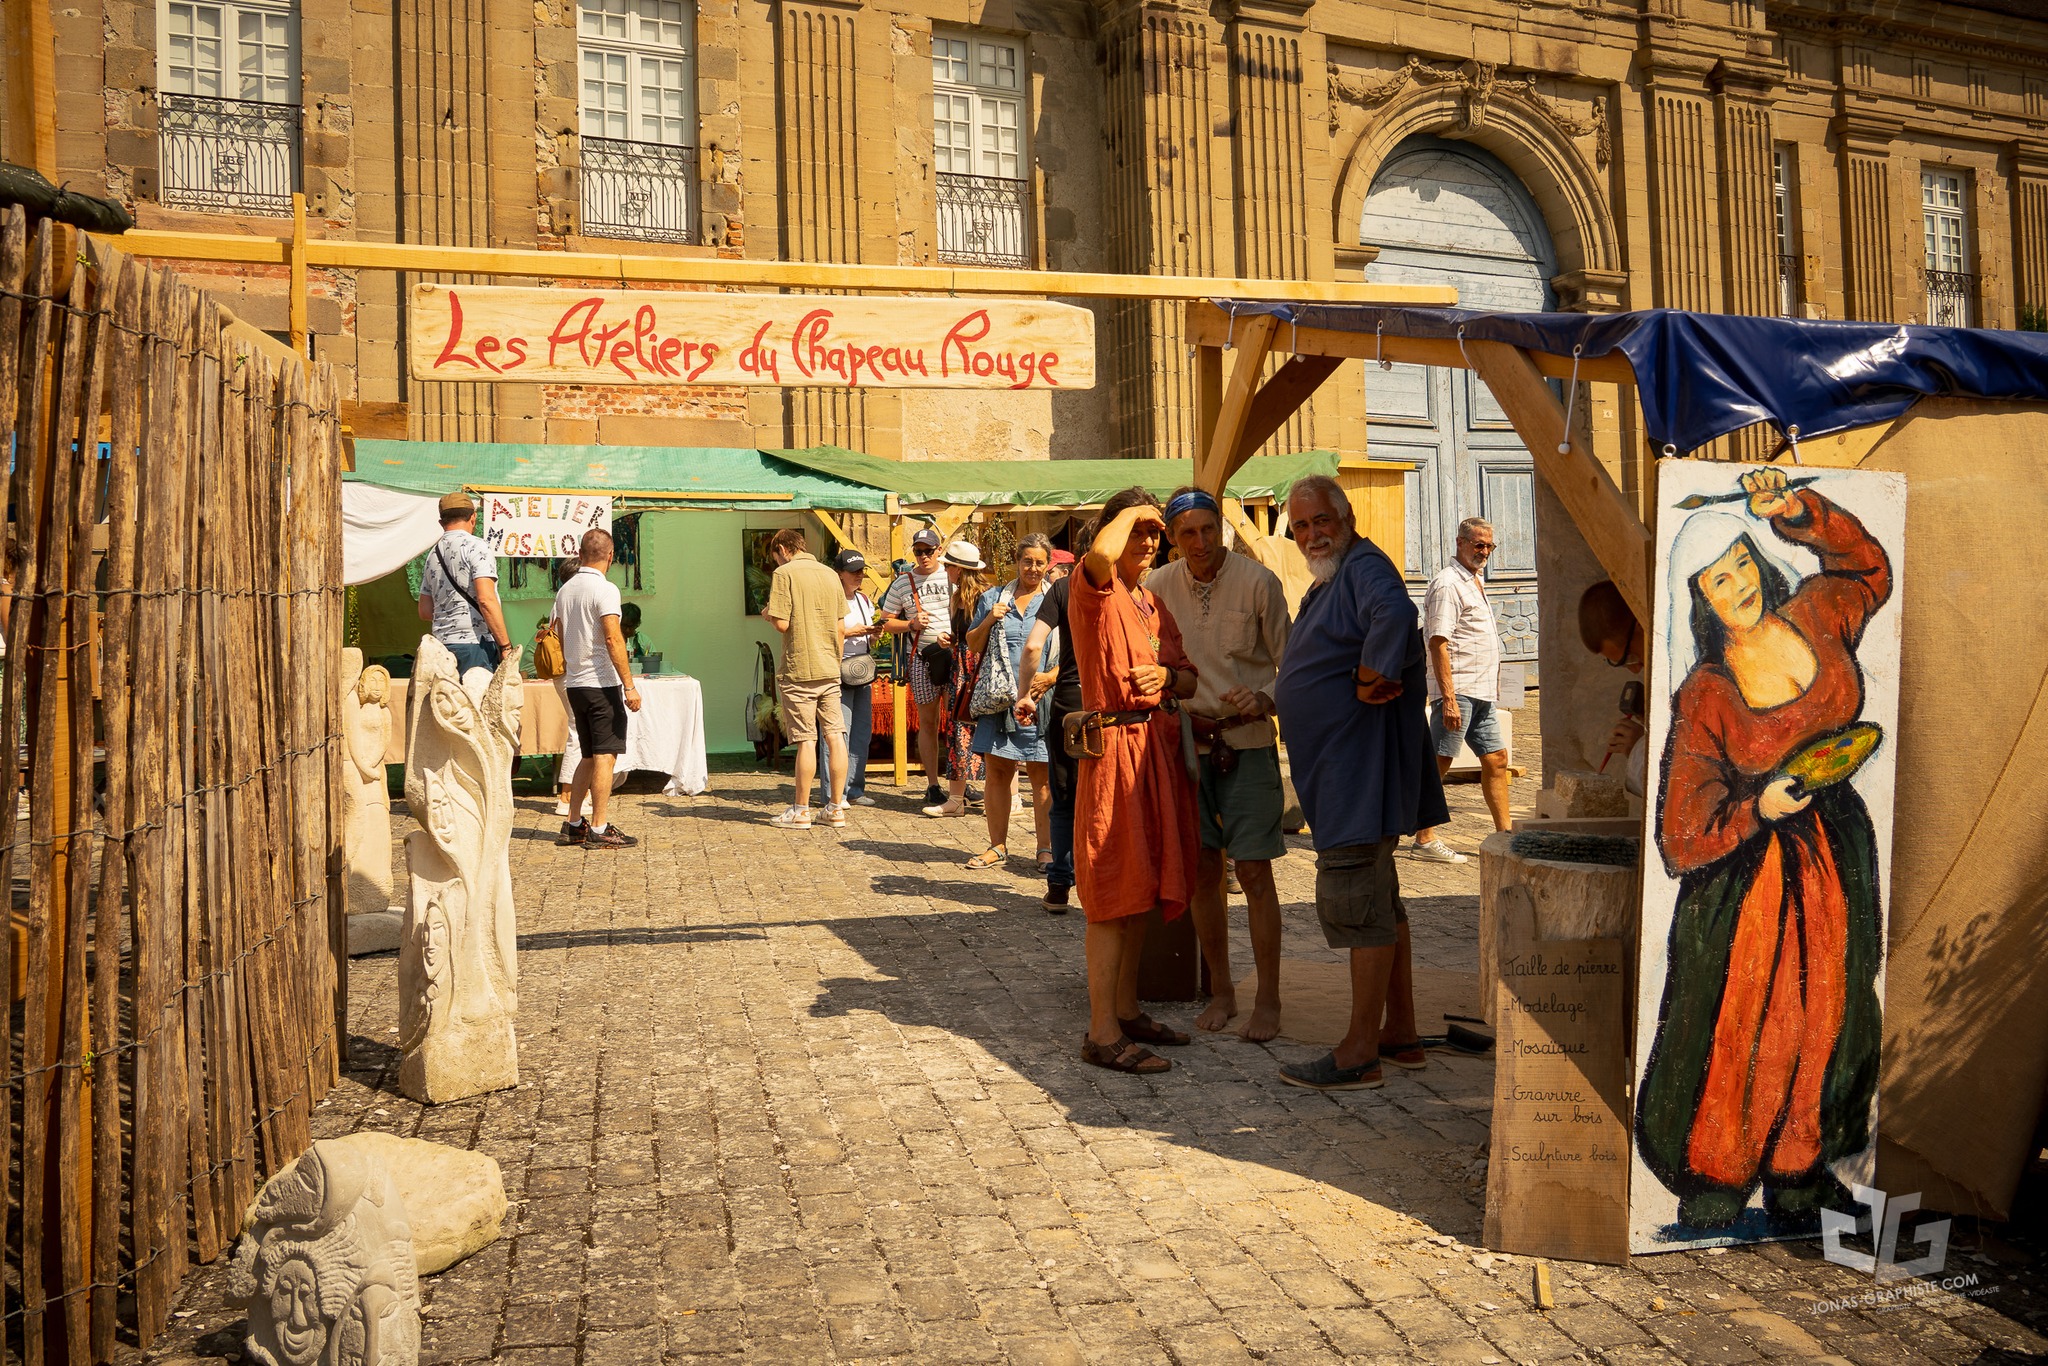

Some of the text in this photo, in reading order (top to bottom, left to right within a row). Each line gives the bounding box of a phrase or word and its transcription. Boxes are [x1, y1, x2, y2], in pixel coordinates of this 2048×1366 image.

[433, 290, 1060, 390] Les Ateliers du Chapeau Rouge
[491, 496, 605, 529] ATELIER
[486, 526, 584, 556] MOSAÏQ
[909, 582, 949, 606] MIAM
[1552, 956, 1569, 976] de
[1574, 960, 1620, 983] pierre
[1532, 1105, 1603, 1124] sur bois
[1589, 1144, 1618, 1162] bois
